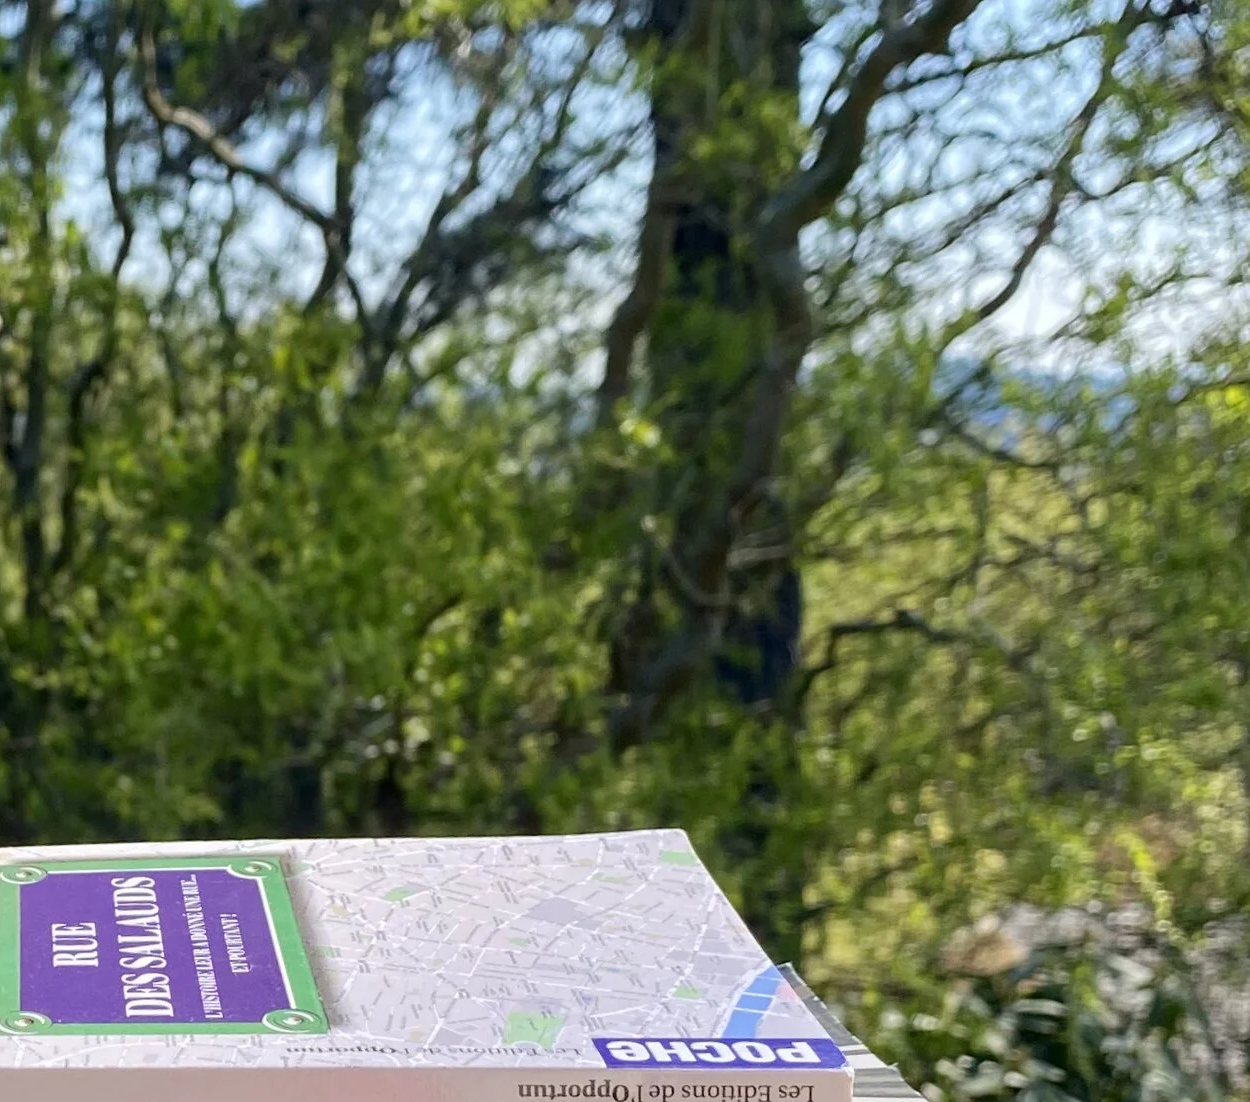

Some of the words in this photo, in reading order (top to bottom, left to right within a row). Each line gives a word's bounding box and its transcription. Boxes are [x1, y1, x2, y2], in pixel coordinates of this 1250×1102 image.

[184, 895, 203, 911] UNE
[111, 876, 168, 970] SALAUDS
[182, 912, 208, 940] DONNÉ
[52, 921, 100, 969] RUE
[192, 948, 214, 970] LEUR
[230, 961, 250, 973] ET
[121, 972, 174, 1018] DES
[197, 971, 224, 1019] L'HISTOIRE
[649, 1083, 675, 1102] de
[778, 1084, 815, 1102] Les
